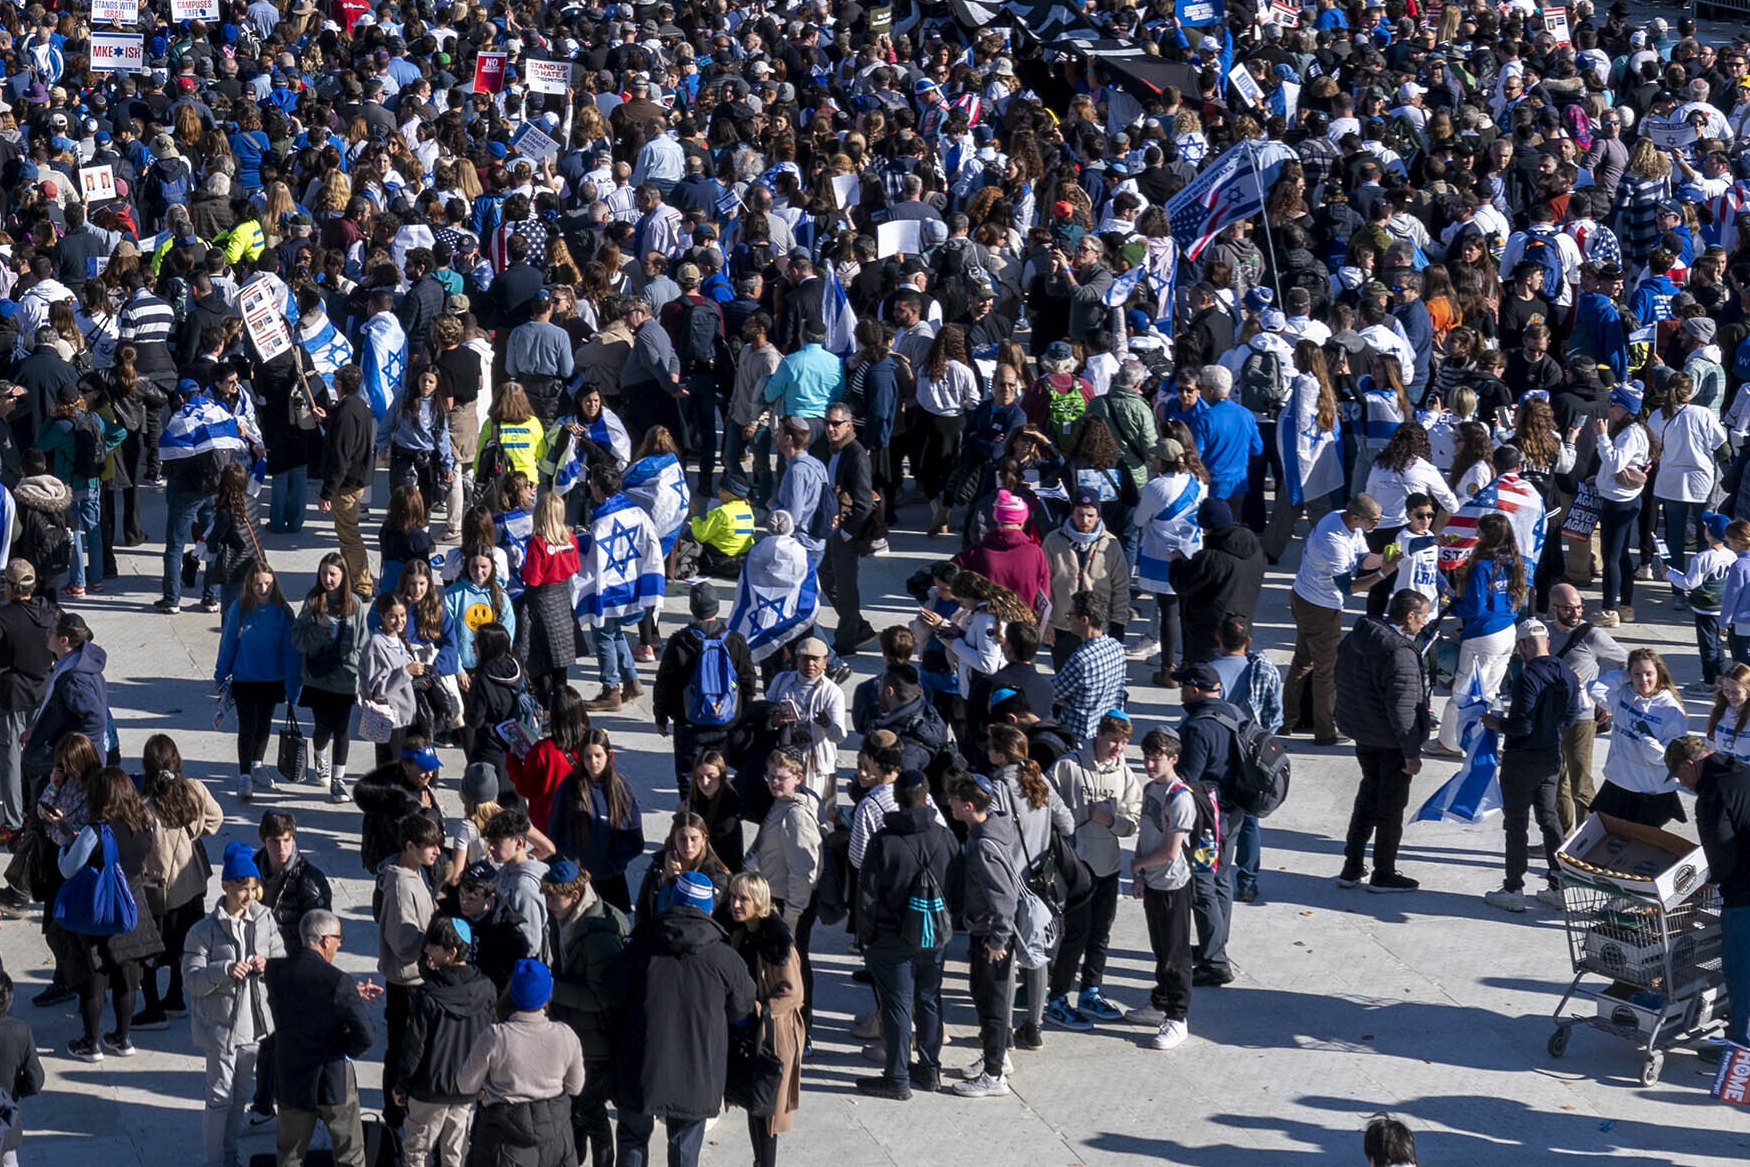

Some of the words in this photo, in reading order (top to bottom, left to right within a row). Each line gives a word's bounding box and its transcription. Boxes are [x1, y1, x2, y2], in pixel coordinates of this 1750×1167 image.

[94, 0, 119, 10] STANDS
[119, 1, 136, 11] WITH
[176, 0, 212, 10] CAMPUSES
[103, 9, 125, 19] ISRAEL
[184, 9, 199, 17] SAFE
[92, 46, 113, 58] MKE
[485, 58, 498, 67] NO
[529, 62, 555, 71] STAND
[540, 70, 560, 78] HATE
[526, 135, 547, 151] STANDS
[529, 130, 549, 145] DALLAS
[518, 144, 537, 158] ISRAEL
[522, 139, 538, 153] WITH
[1210, 164, 1235, 183] ISRAEL
[1574, 492, 1603, 510] AGAIN
[1568, 507, 1598, 523] NEVER
[1563, 518, 1595, 535] AGAIN
[1442, 545, 1472, 562] STA
[1723, 1050, 1750, 1102] HOME
